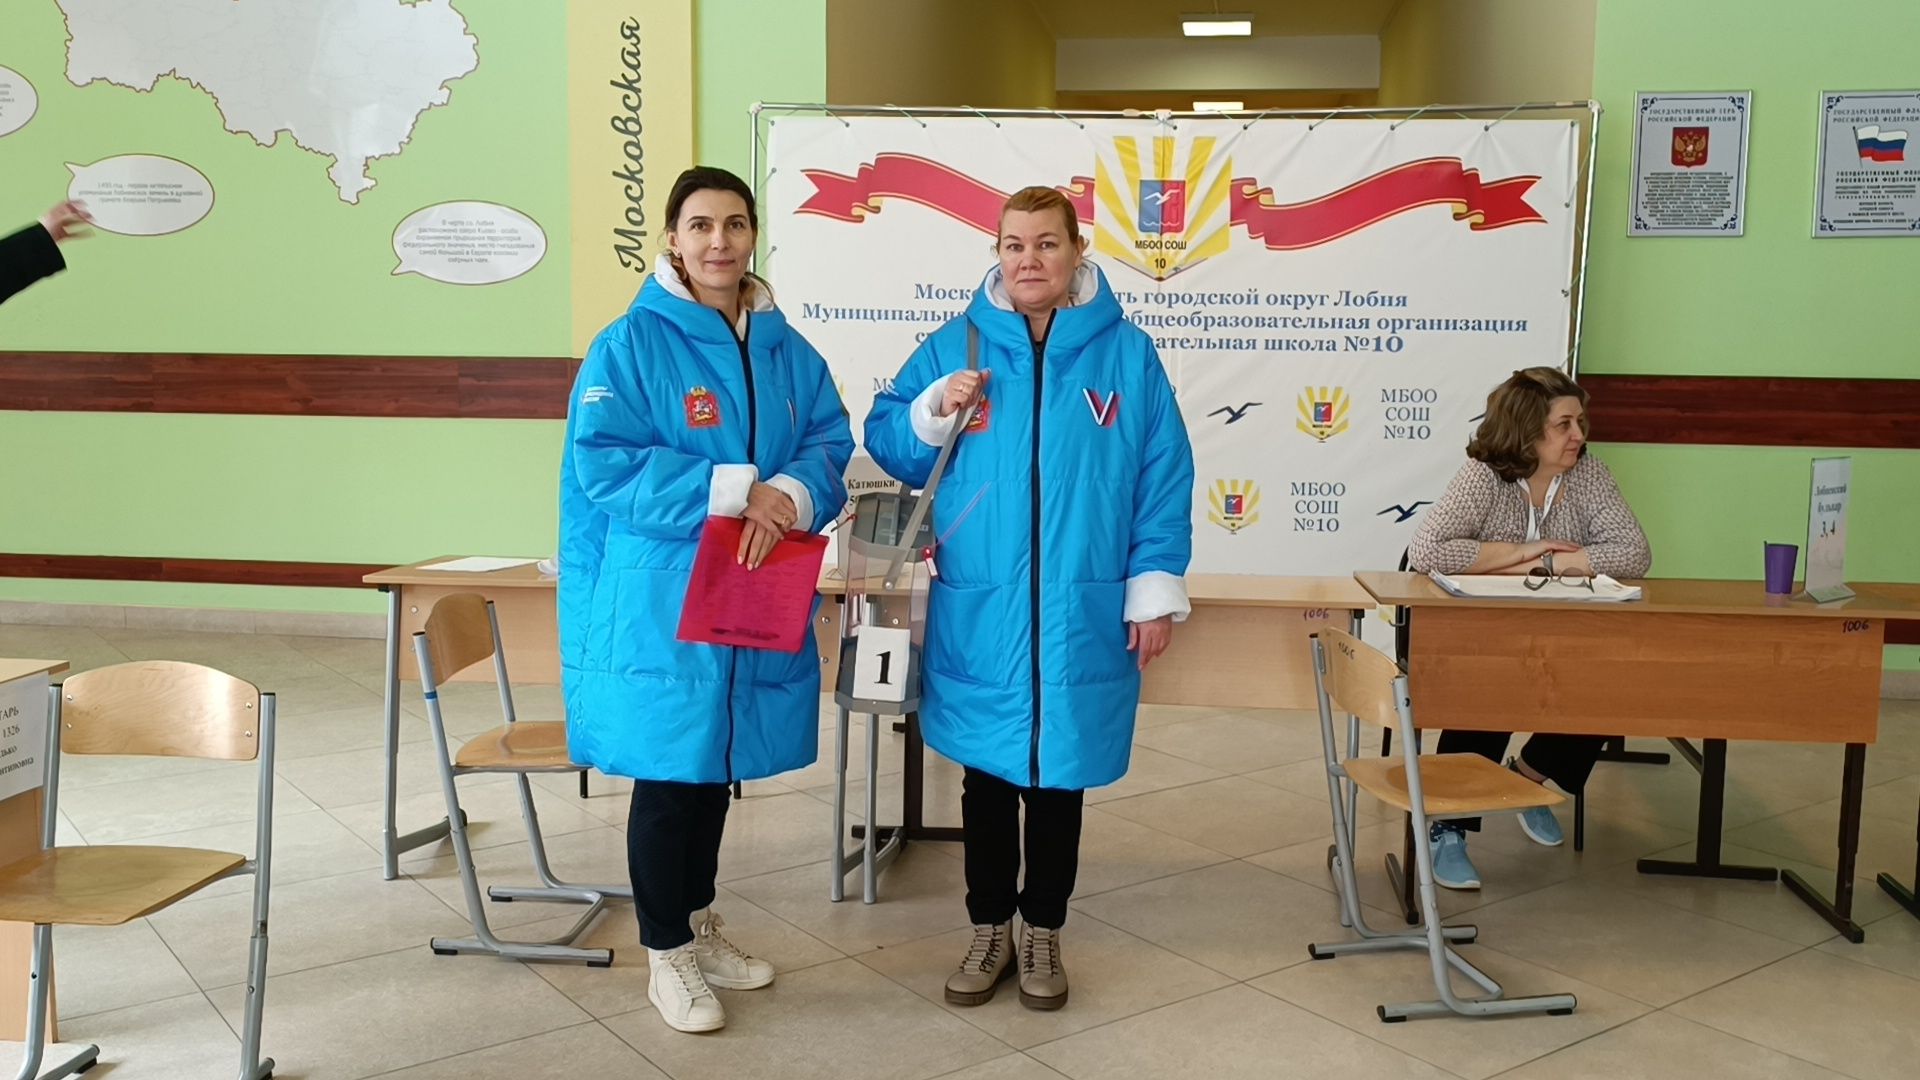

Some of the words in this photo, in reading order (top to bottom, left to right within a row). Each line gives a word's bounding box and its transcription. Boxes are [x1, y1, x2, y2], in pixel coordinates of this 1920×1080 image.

[610, 16, 647, 273] Московская
[1135, 240, 1163, 249] МБОО
[1164, 240, 1187, 250] СОШ
[1154, 258, 1166, 269] 10
[1144, 288, 1260, 308] городской
[1265, 292, 1330, 310] округ
[1333, 289, 1408, 308] Лобня
[1376, 316, 1528, 335] организация
[1264, 336, 1337, 352] школа
[1343, 335, 1404, 352] №10
[1380, 388, 1438, 403] МБОО
[1385, 407, 1430, 421] СОШ
[1383, 425, 1431, 440] №10
[1290, 482, 1346, 497] МБОО
[1294, 500, 1339, 514] СОШ
[1293, 518, 1340, 532] №10
[1303, 607, 1329, 621] 1006
[1842, 619, 1869, 633] 1006
[873, 651, 893, 686] 1
[3, 725, 20, 738] 1326
